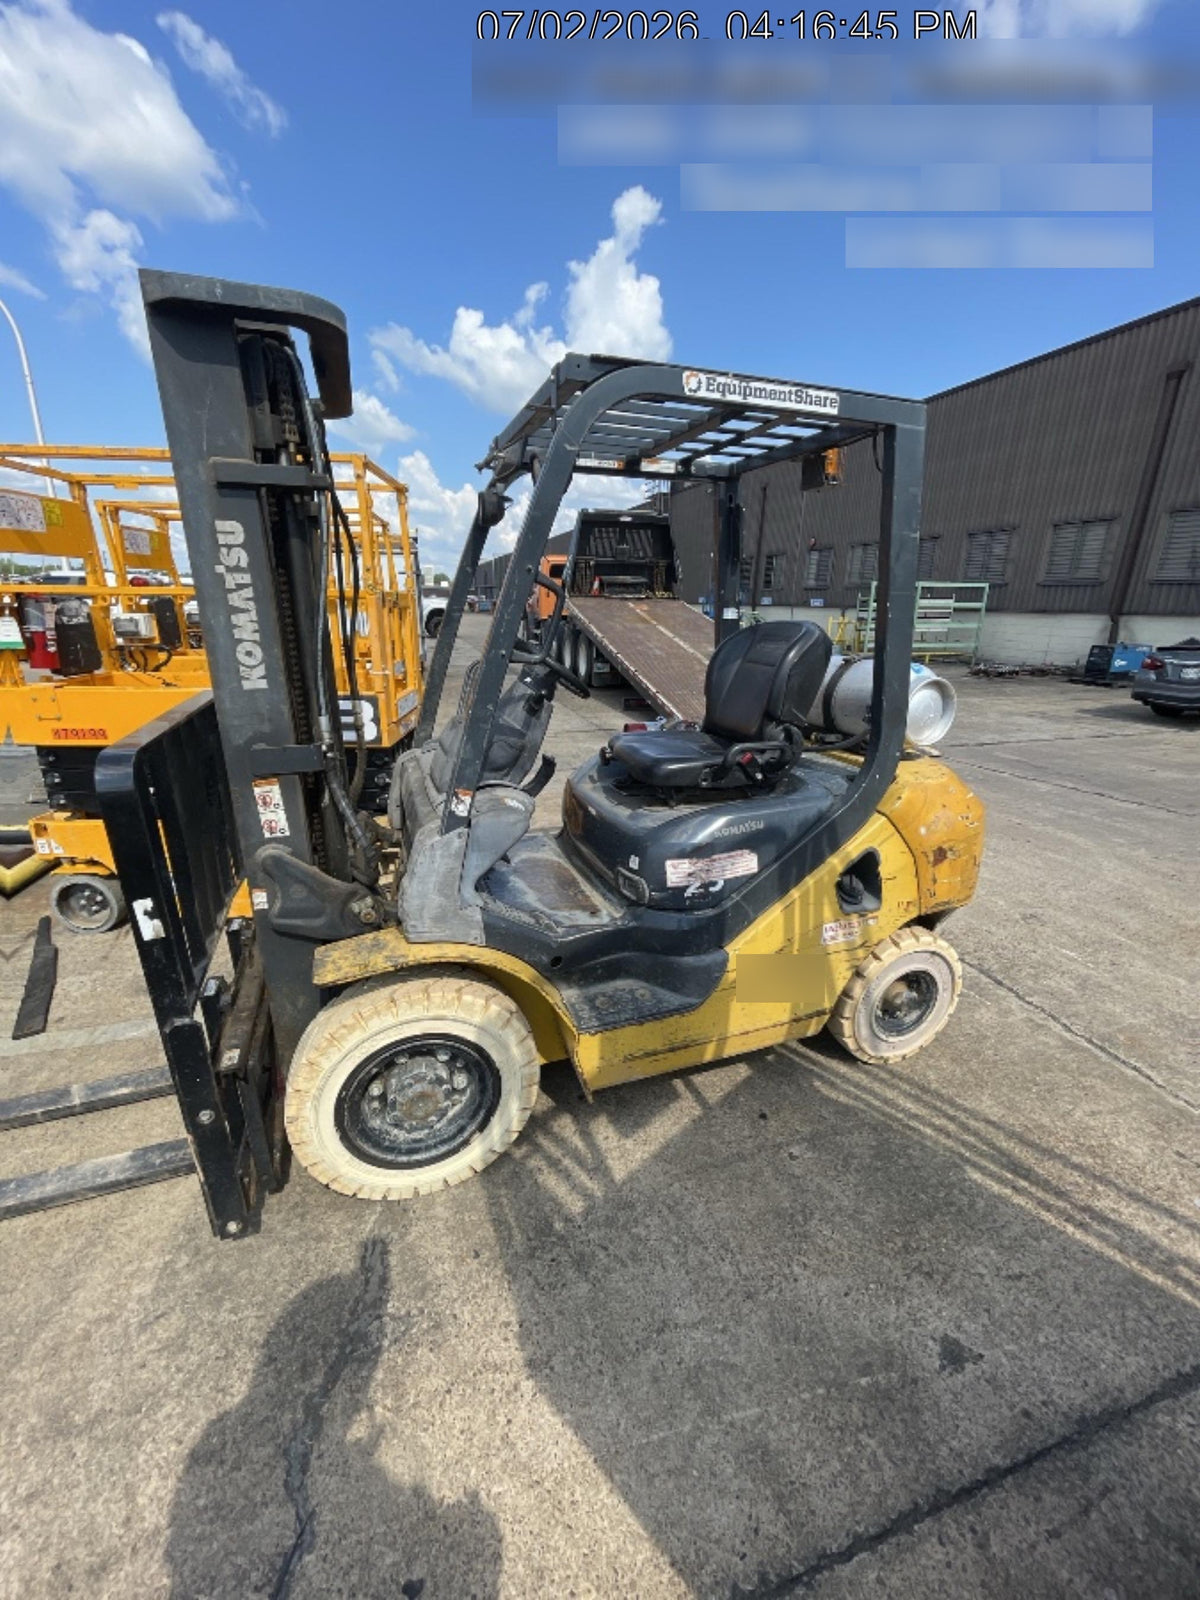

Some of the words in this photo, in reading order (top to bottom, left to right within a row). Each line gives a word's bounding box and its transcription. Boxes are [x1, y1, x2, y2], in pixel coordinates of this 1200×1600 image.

[705, 376, 838, 408] EquipmentShare
[214, 520, 269, 690] KOMATSU
[713, 819, 764, 838] KOMATSU
